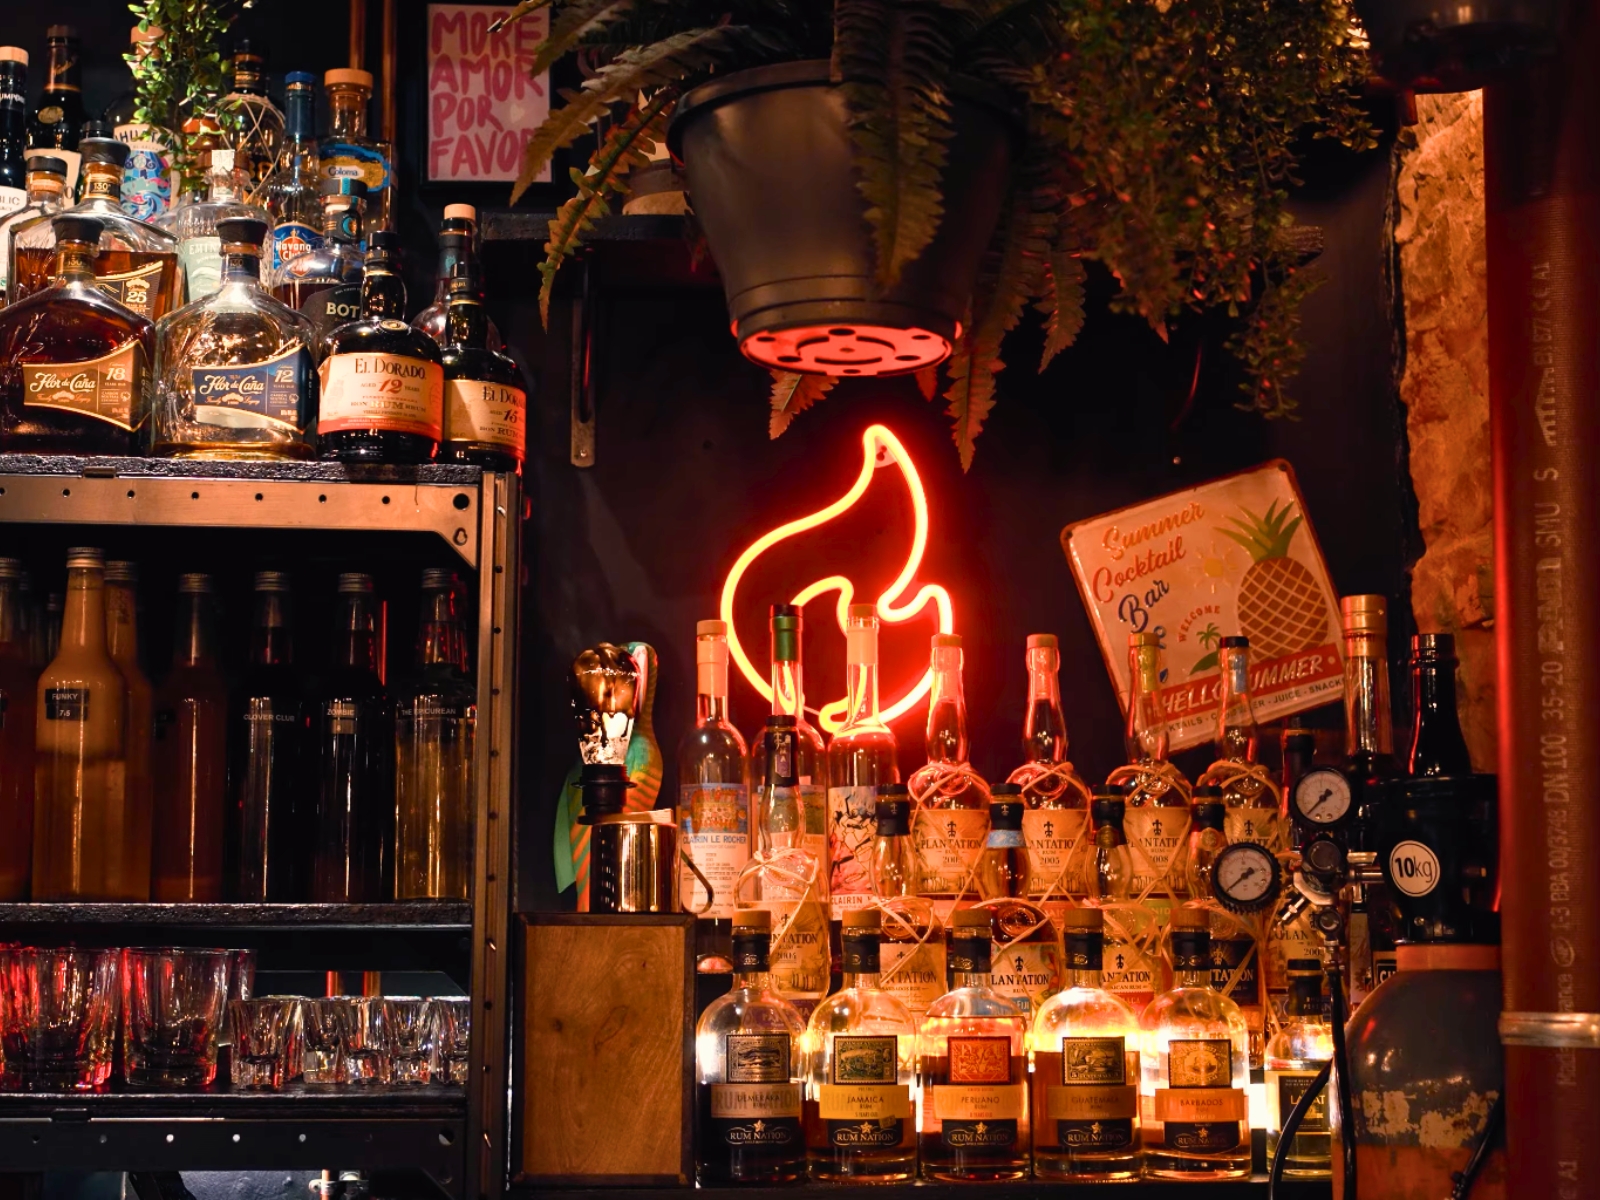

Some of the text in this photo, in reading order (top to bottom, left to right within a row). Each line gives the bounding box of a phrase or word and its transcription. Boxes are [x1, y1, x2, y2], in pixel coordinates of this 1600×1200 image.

[431, 11, 542, 59] MORE
[430, 53, 544, 103] AMOR
[432, 92, 504, 138] POR
[125, 291, 147, 304] 25
[325, 302, 361, 318] BOT
[106, 367, 126, 381] 18
[274, 369, 294, 383] 12
[374, 358, 426, 380] DORADO
[30, 372, 97, 393] Flor de Caña
[199, 374, 265, 395] Flor de Caña
[378, 378, 403, 394] 12
[370, 400, 404, 410] RUM
[503, 408, 518, 424] 15
[1532, 466, 1560, 482] S
[1102, 503, 1205, 560] Summer
[1533, 501, 1563, 548] SMU
[1092, 535, 1187, 604] Cocktail
[1118, 579, 1170, 634] Bar
[1178, 604, 1221, 643] WELCOME
[51, 693, 79, 701] FUNKY
[1160, 680, 1223, 715] HELLO
[1273, 690, 1303, 704] JUICE
[1540, 660, 1565, 721] 35-20
[275, 714, 296, 723] CLUB
[1539, 734, 1568, 770] 100
[1541, 772, 1570, 804] DN
[710, 834, 721, 844] LE
[723, 834, 747, 845] ROCHER
[1394, 855, 1433, 884] 10kg
[1548, 872, 1570, 902] BBA
[991, 973, 1050, 986] LANTATION
[847, 1096, 884, 1104] JAMAICA
[961, 1096, 1000, 1104] PERUANO
[1180, 1099, 1224, 1107] BARBADOS
[730, 1131, 788, 1140] RUM NATION
[836, 1132, 894, 1141] RUM NATION
[951, 1133, 973, 1142] RUM
[1067, 1133, 1089, 1142] RUM
